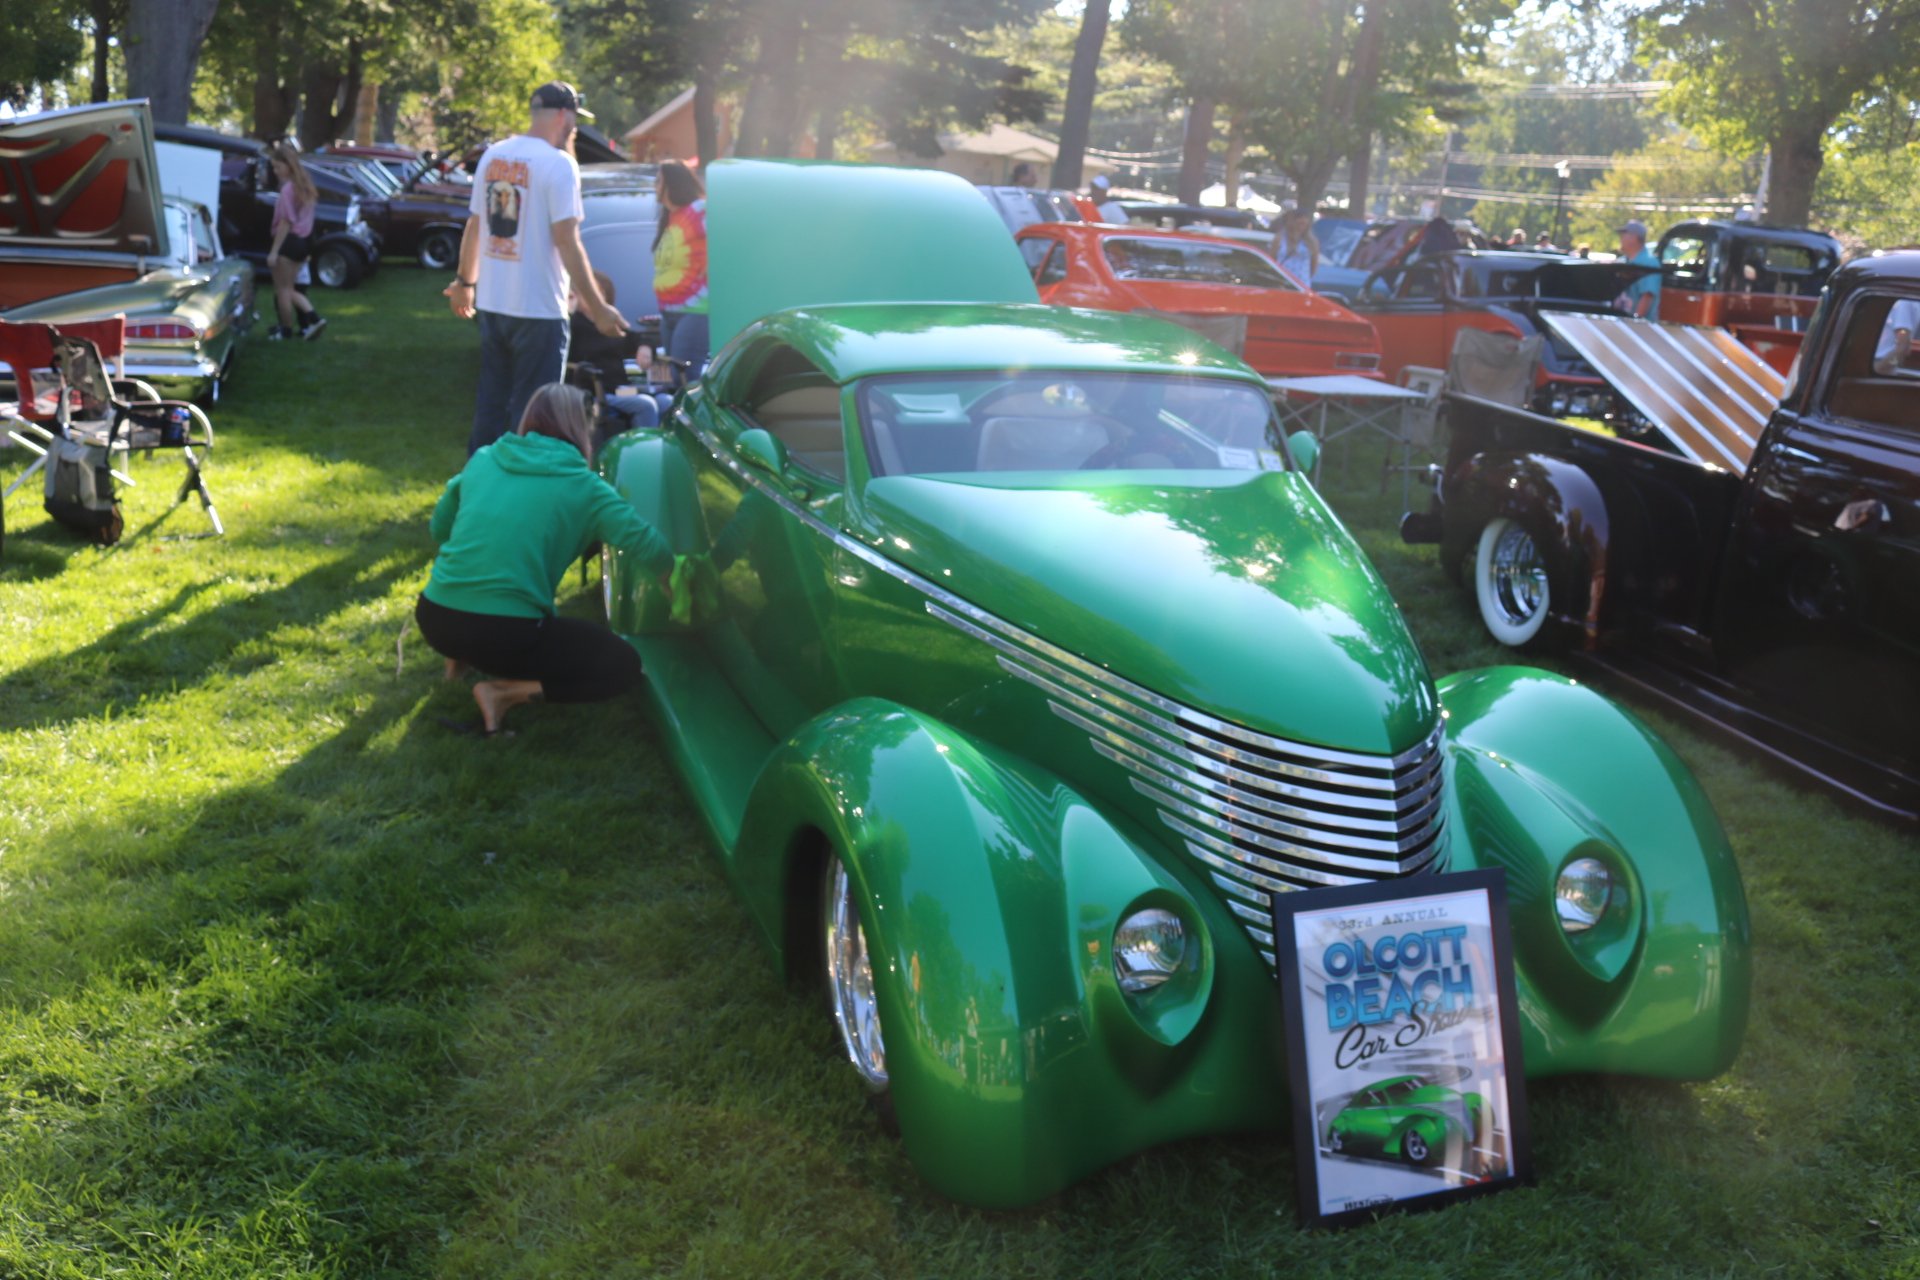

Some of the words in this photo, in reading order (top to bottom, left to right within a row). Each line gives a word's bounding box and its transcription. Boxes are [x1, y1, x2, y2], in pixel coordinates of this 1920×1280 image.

[1381, 907, 1448, 926] ANNUAL
[1323, 924, 1467, 978] OLCOTT
[1325, 964, 1474, 1031] BEACH
[1335, 1023, 1389, 1070] Car
[1394, 999, 1474, 1047] Show
